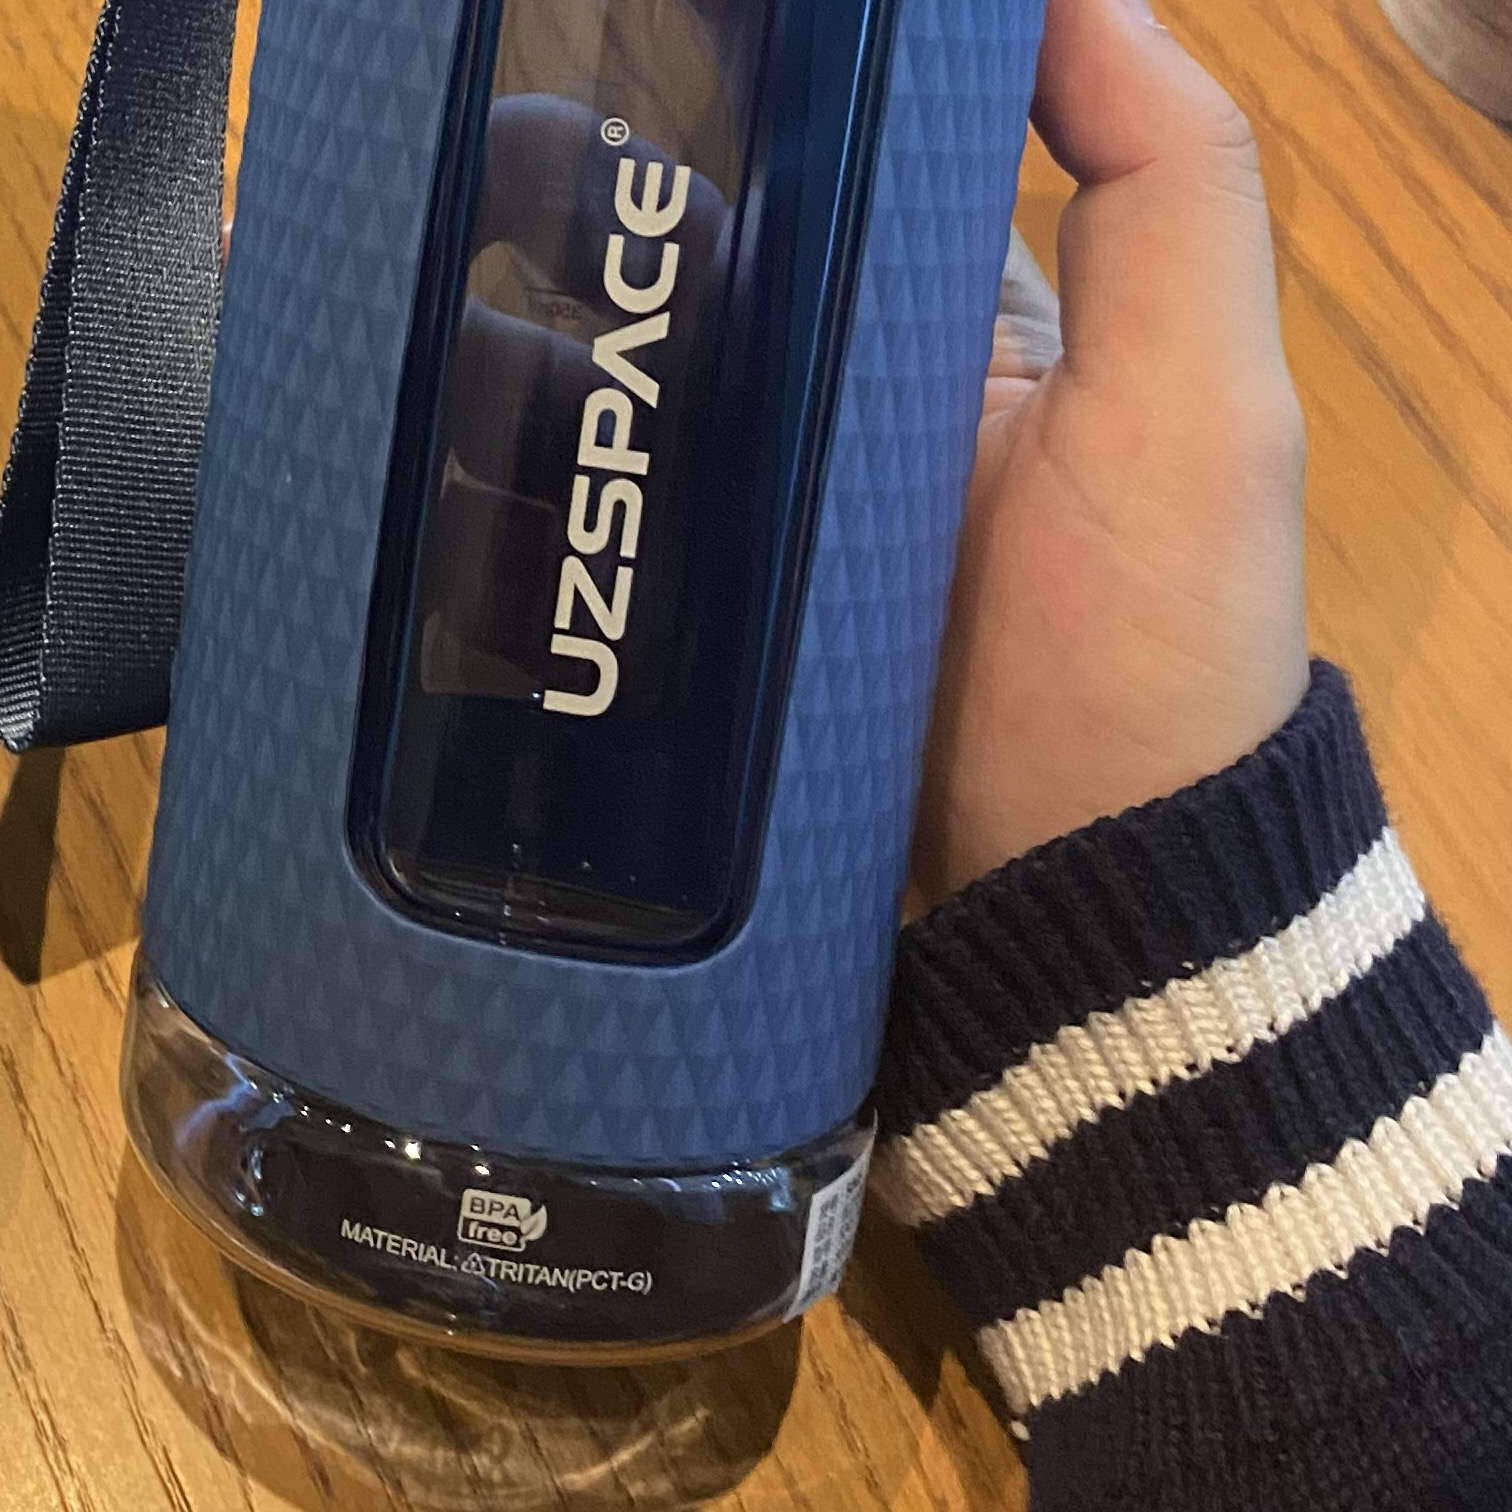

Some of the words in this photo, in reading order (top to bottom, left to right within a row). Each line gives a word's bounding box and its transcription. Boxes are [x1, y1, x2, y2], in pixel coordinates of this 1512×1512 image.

[543, 157, 691, 716] UZSPACE
[467, 1219, 519, 1245] free
[469, 1196, 521, 1221] BPA
[340, 1218, 459, 1272] MATERIAL:
[481, 1254, 652, 1295] TRITAN(PCT-G)
